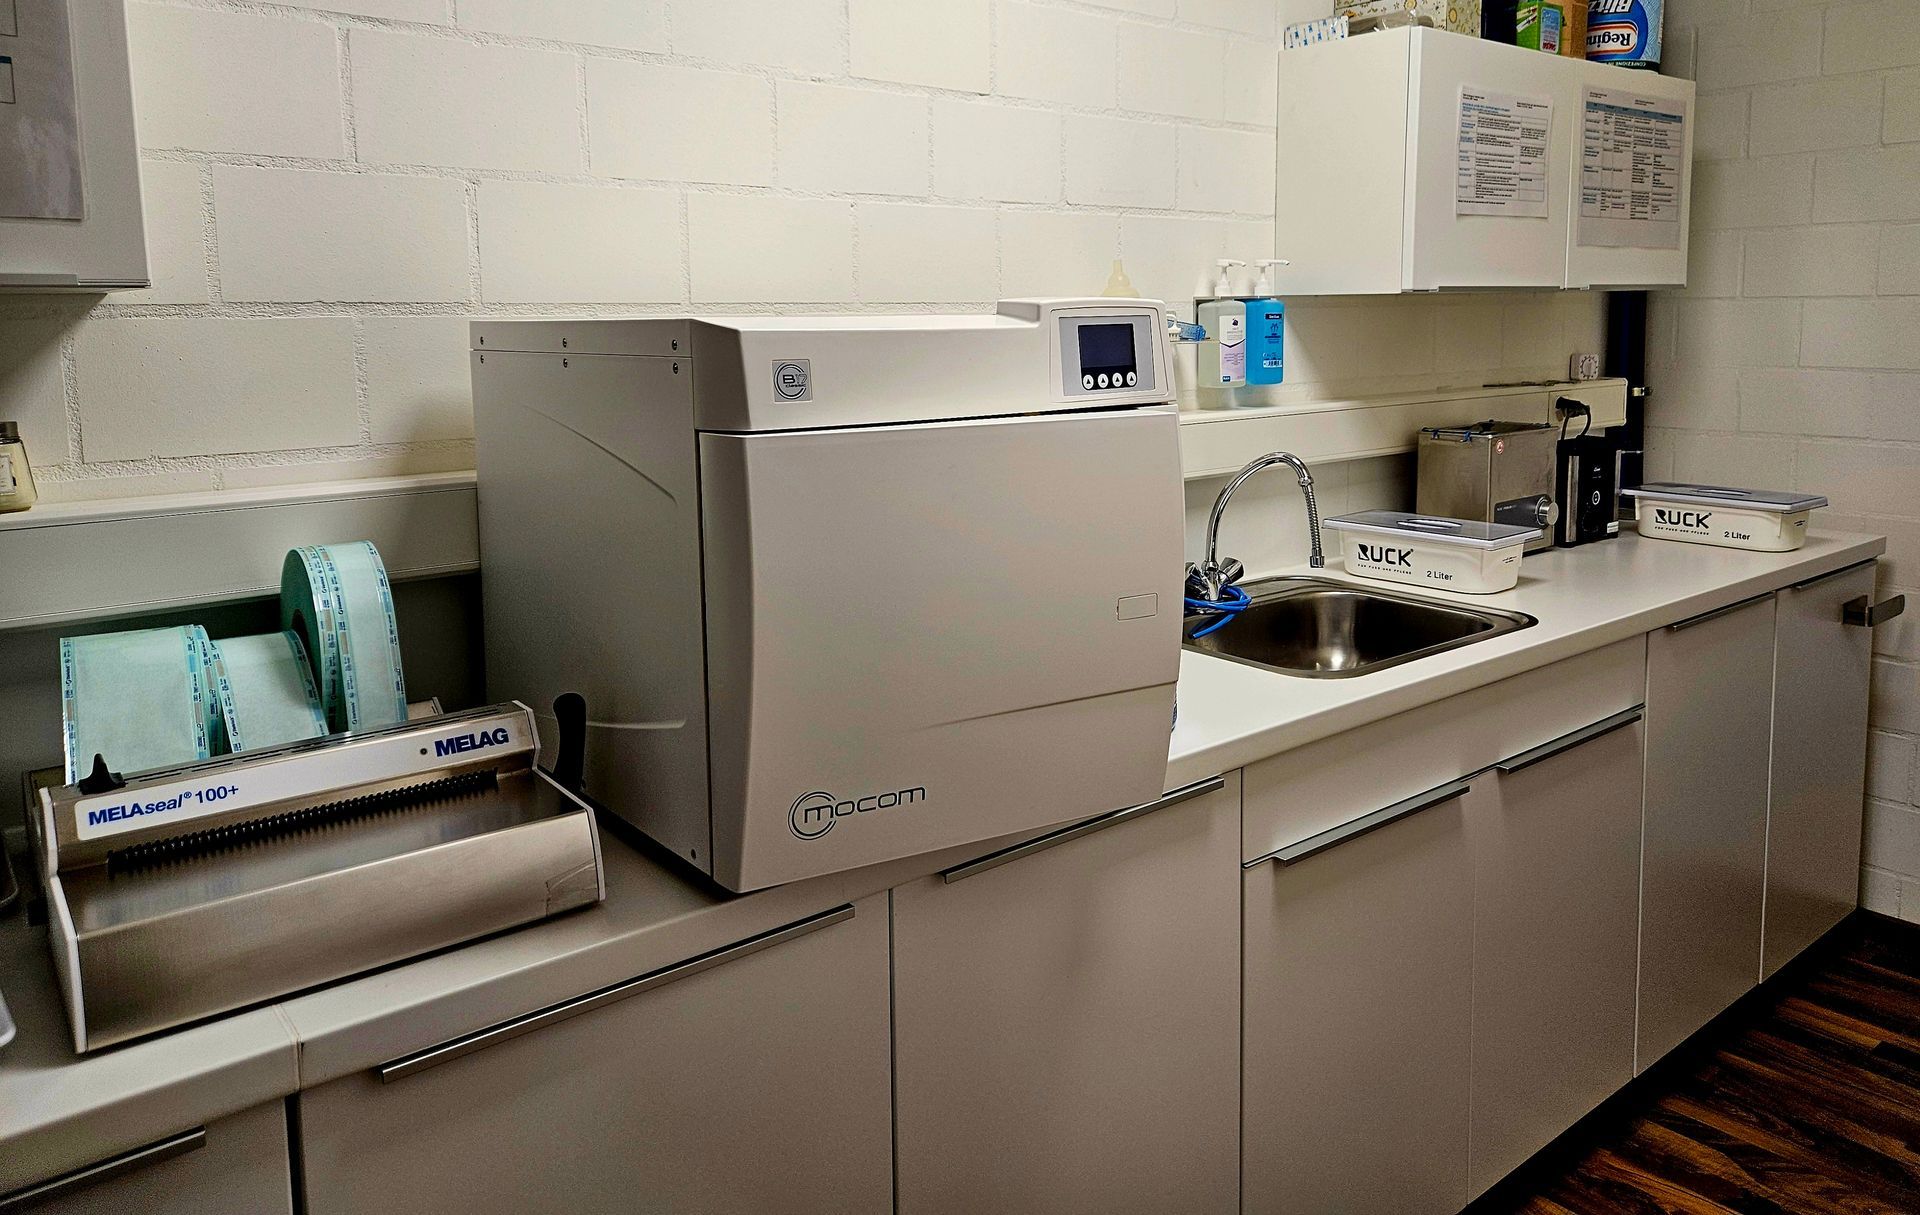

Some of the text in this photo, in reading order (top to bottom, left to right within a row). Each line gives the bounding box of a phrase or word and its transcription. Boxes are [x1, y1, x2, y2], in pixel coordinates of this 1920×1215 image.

[1587, 32, 1631, 48] Regin
[1731, 531, 1751, 541] Liter
[1426, 570, 1453, 581] 2 Liter
[434, 727, 509, 757] MELAG
[194, 785, 239, 804] 100+
[804, 787, 925, 823] mocom
